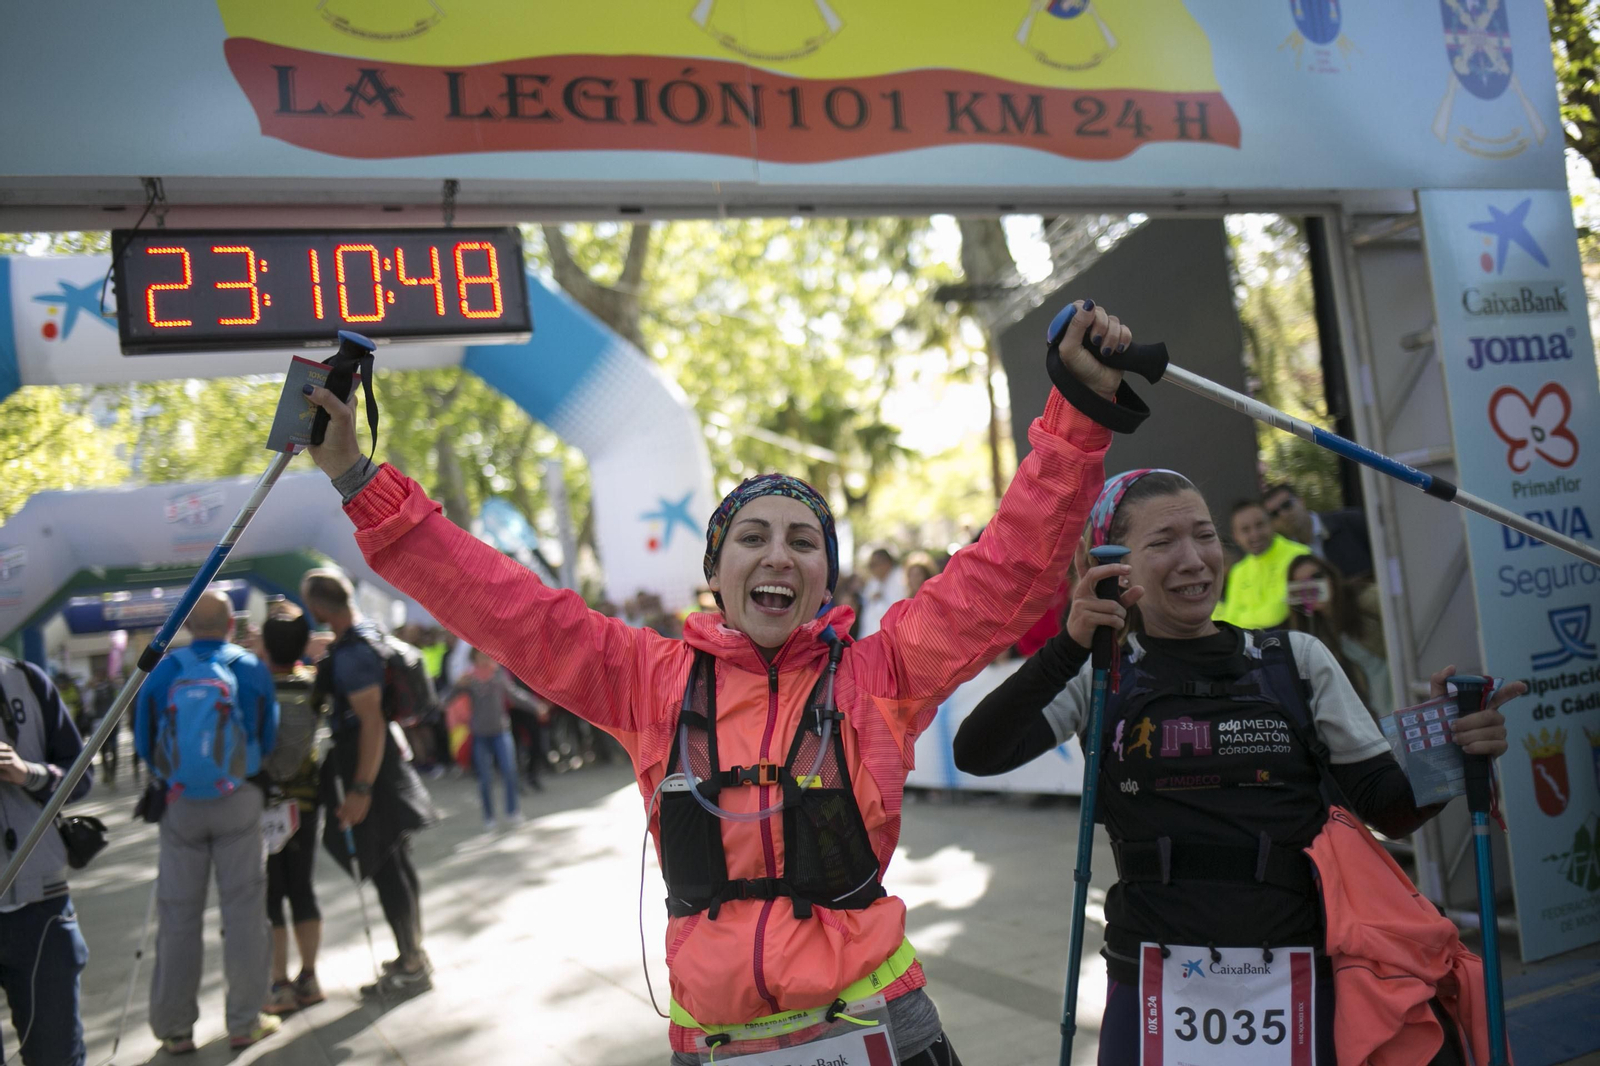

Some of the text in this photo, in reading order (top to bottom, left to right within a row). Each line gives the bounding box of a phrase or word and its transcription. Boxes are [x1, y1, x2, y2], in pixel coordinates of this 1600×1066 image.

[273, 65, 413, 120] LA
[944, 90, 1049, 136] KM
[1073, 96, 1152, 139] 24
[1173, 99, 1213, 141] H
[144, 240, 504, 328] 23:10:48
[1462, 286, 1569, 317] CaixaBank
[1512, 475, 1582, 499] Primaflor
[1498, 560, 1600, 599] Seguro
[1532, 701, 1556, 721] de
[1218, 719, 1289, 733] edp MEDIA
[1219, 729, 1290, 745] MARATÓN
[1218, 744, 1292, 756] CÓRDOBA 2017
[1120, 777, 1140, 796] edp
[1170, 774, 1222, 787] IMDECO
[1209, 961, 1272, 976] CaixaBank
[1174, 1006, 1287, 1046] 3035
